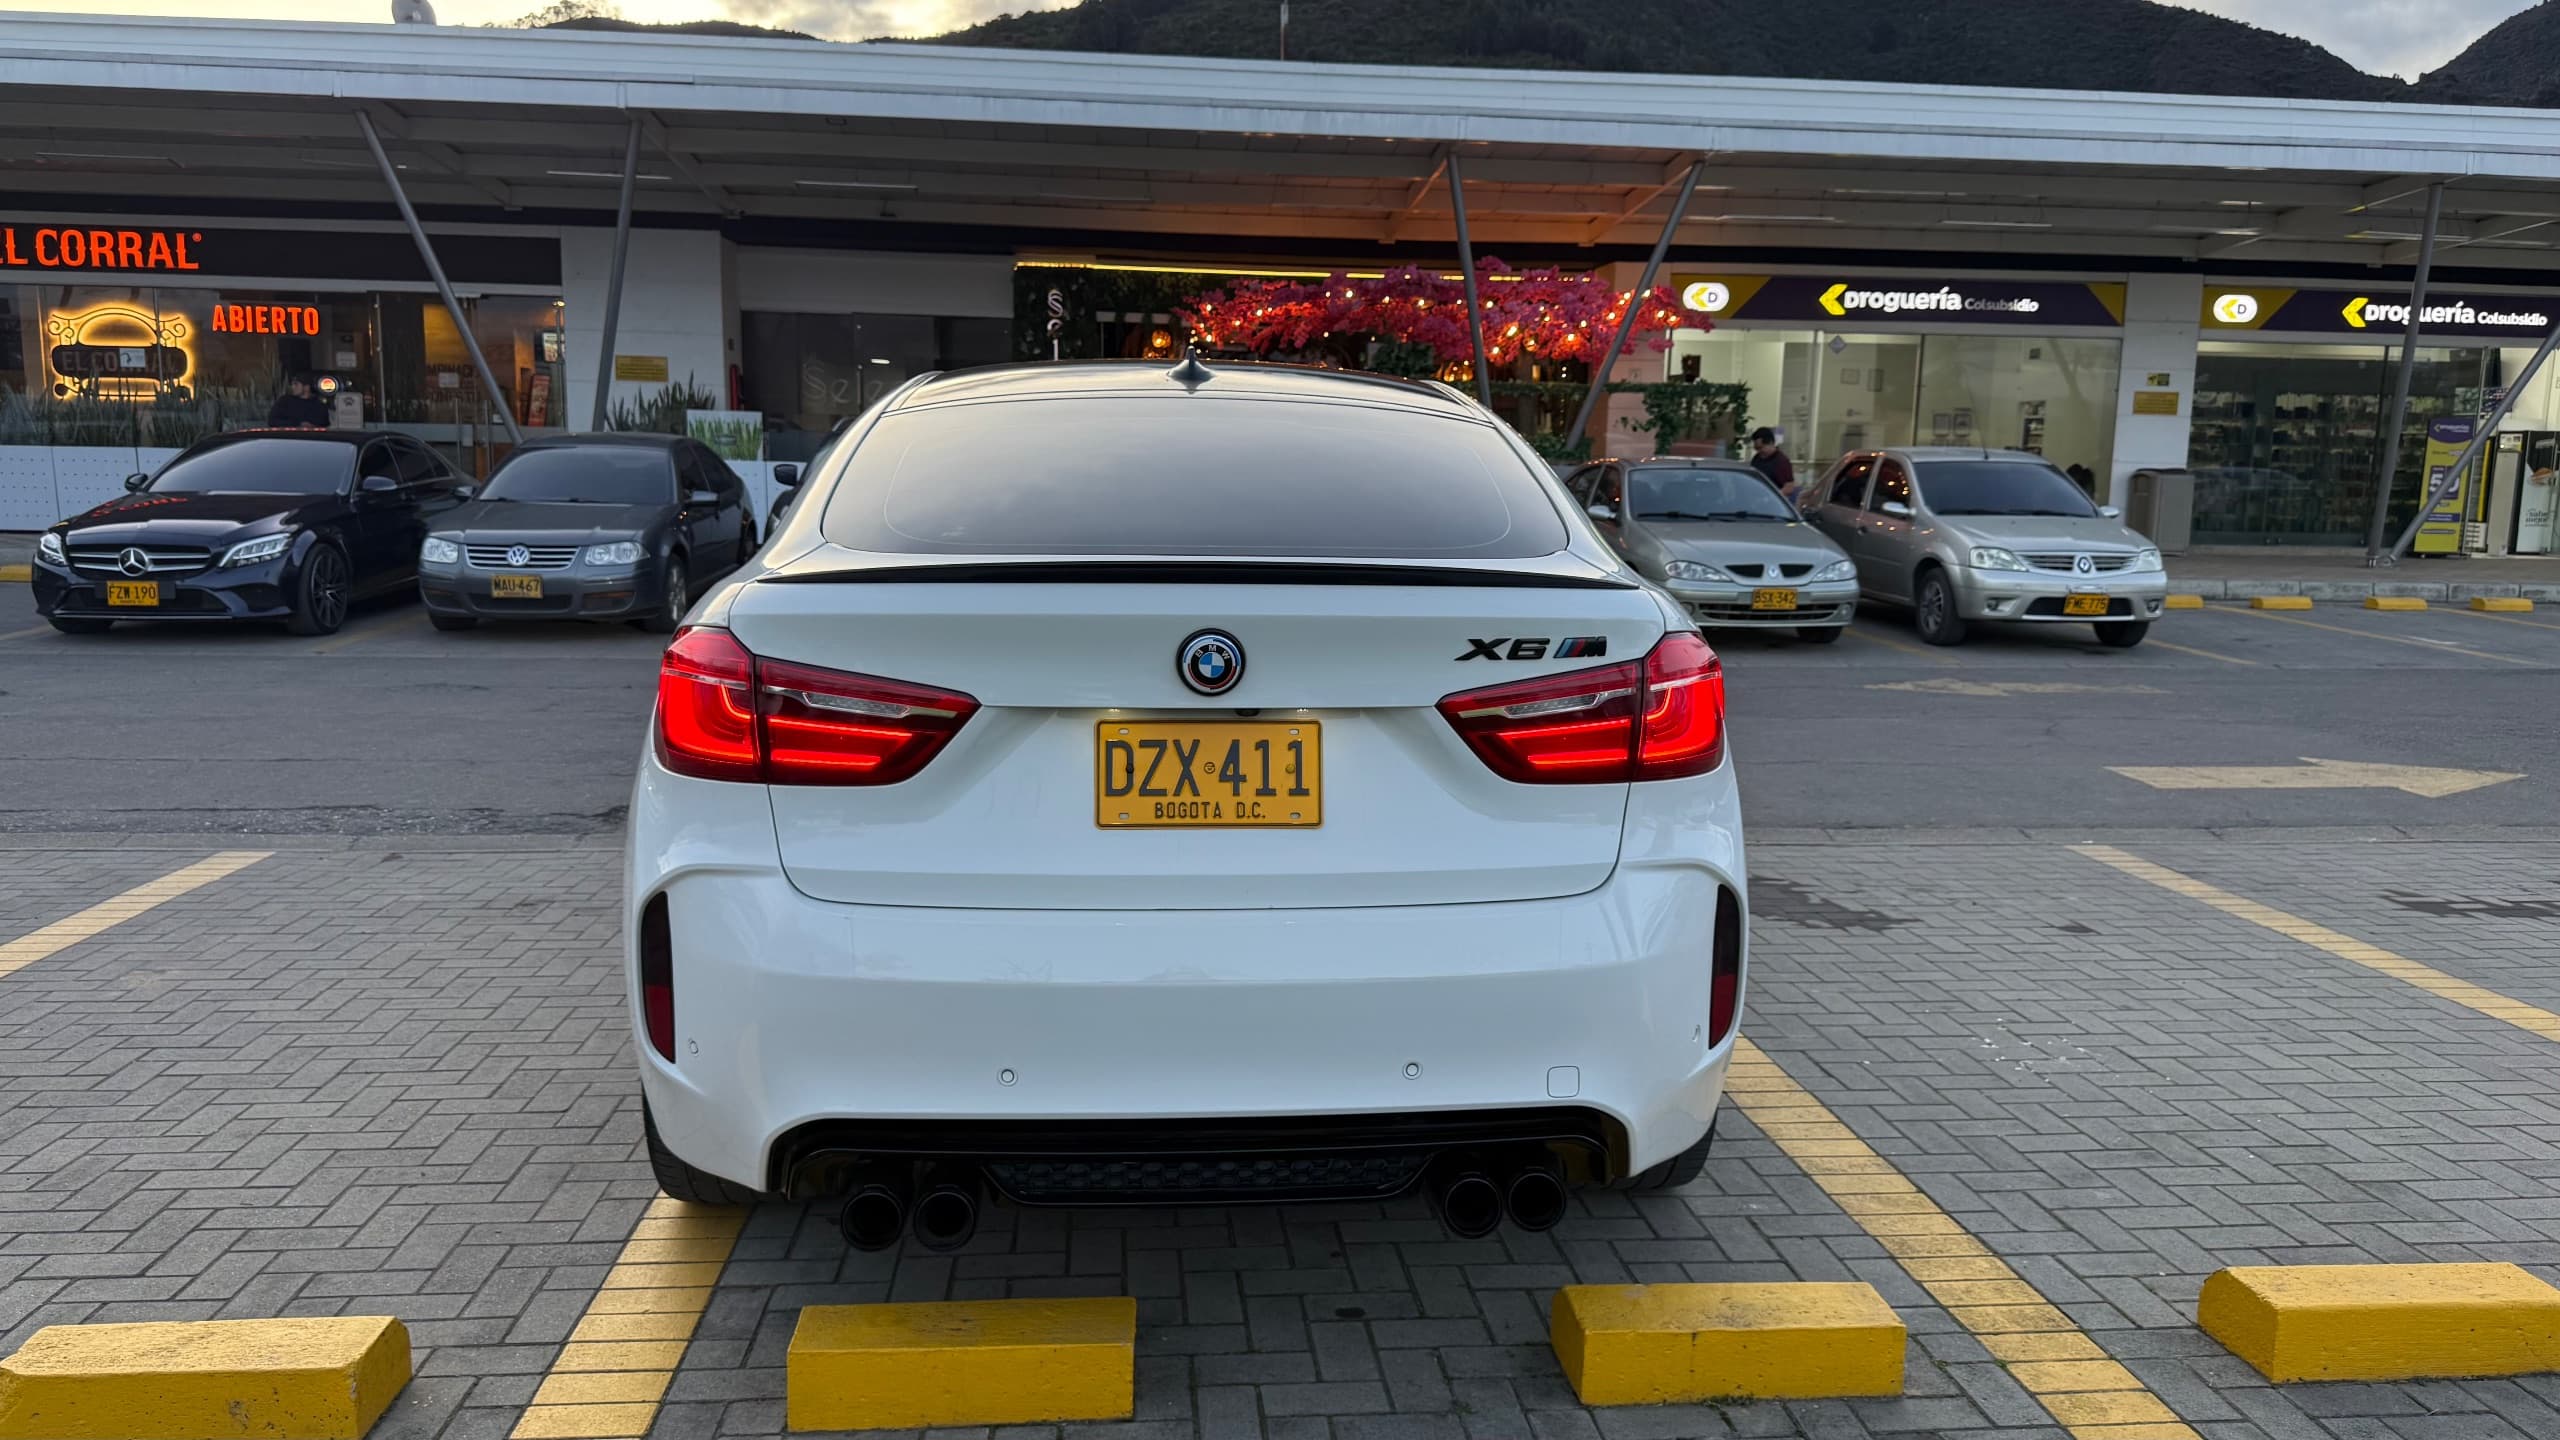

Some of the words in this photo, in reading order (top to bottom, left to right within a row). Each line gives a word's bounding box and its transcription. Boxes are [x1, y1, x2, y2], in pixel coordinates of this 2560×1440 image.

[0, 227, 29, 265] L
[1844, 286, 1962, 313] Droguería
[212, 304, 320, 336] ABIERTO
[2477, 311, 2548, 326] Colsubsidio
[134, 585, 156, 600] 190
[1195, 643, 1231, 660] BMW
[1454, 637, 1551, 662] X6
[1105, 739, 1200, 797] DZX
[1218, 739, 1310, 797] 411
[1154, 801, 1222, 819] BOGOTA
[1236, 801, 1266, 819] D.C.
